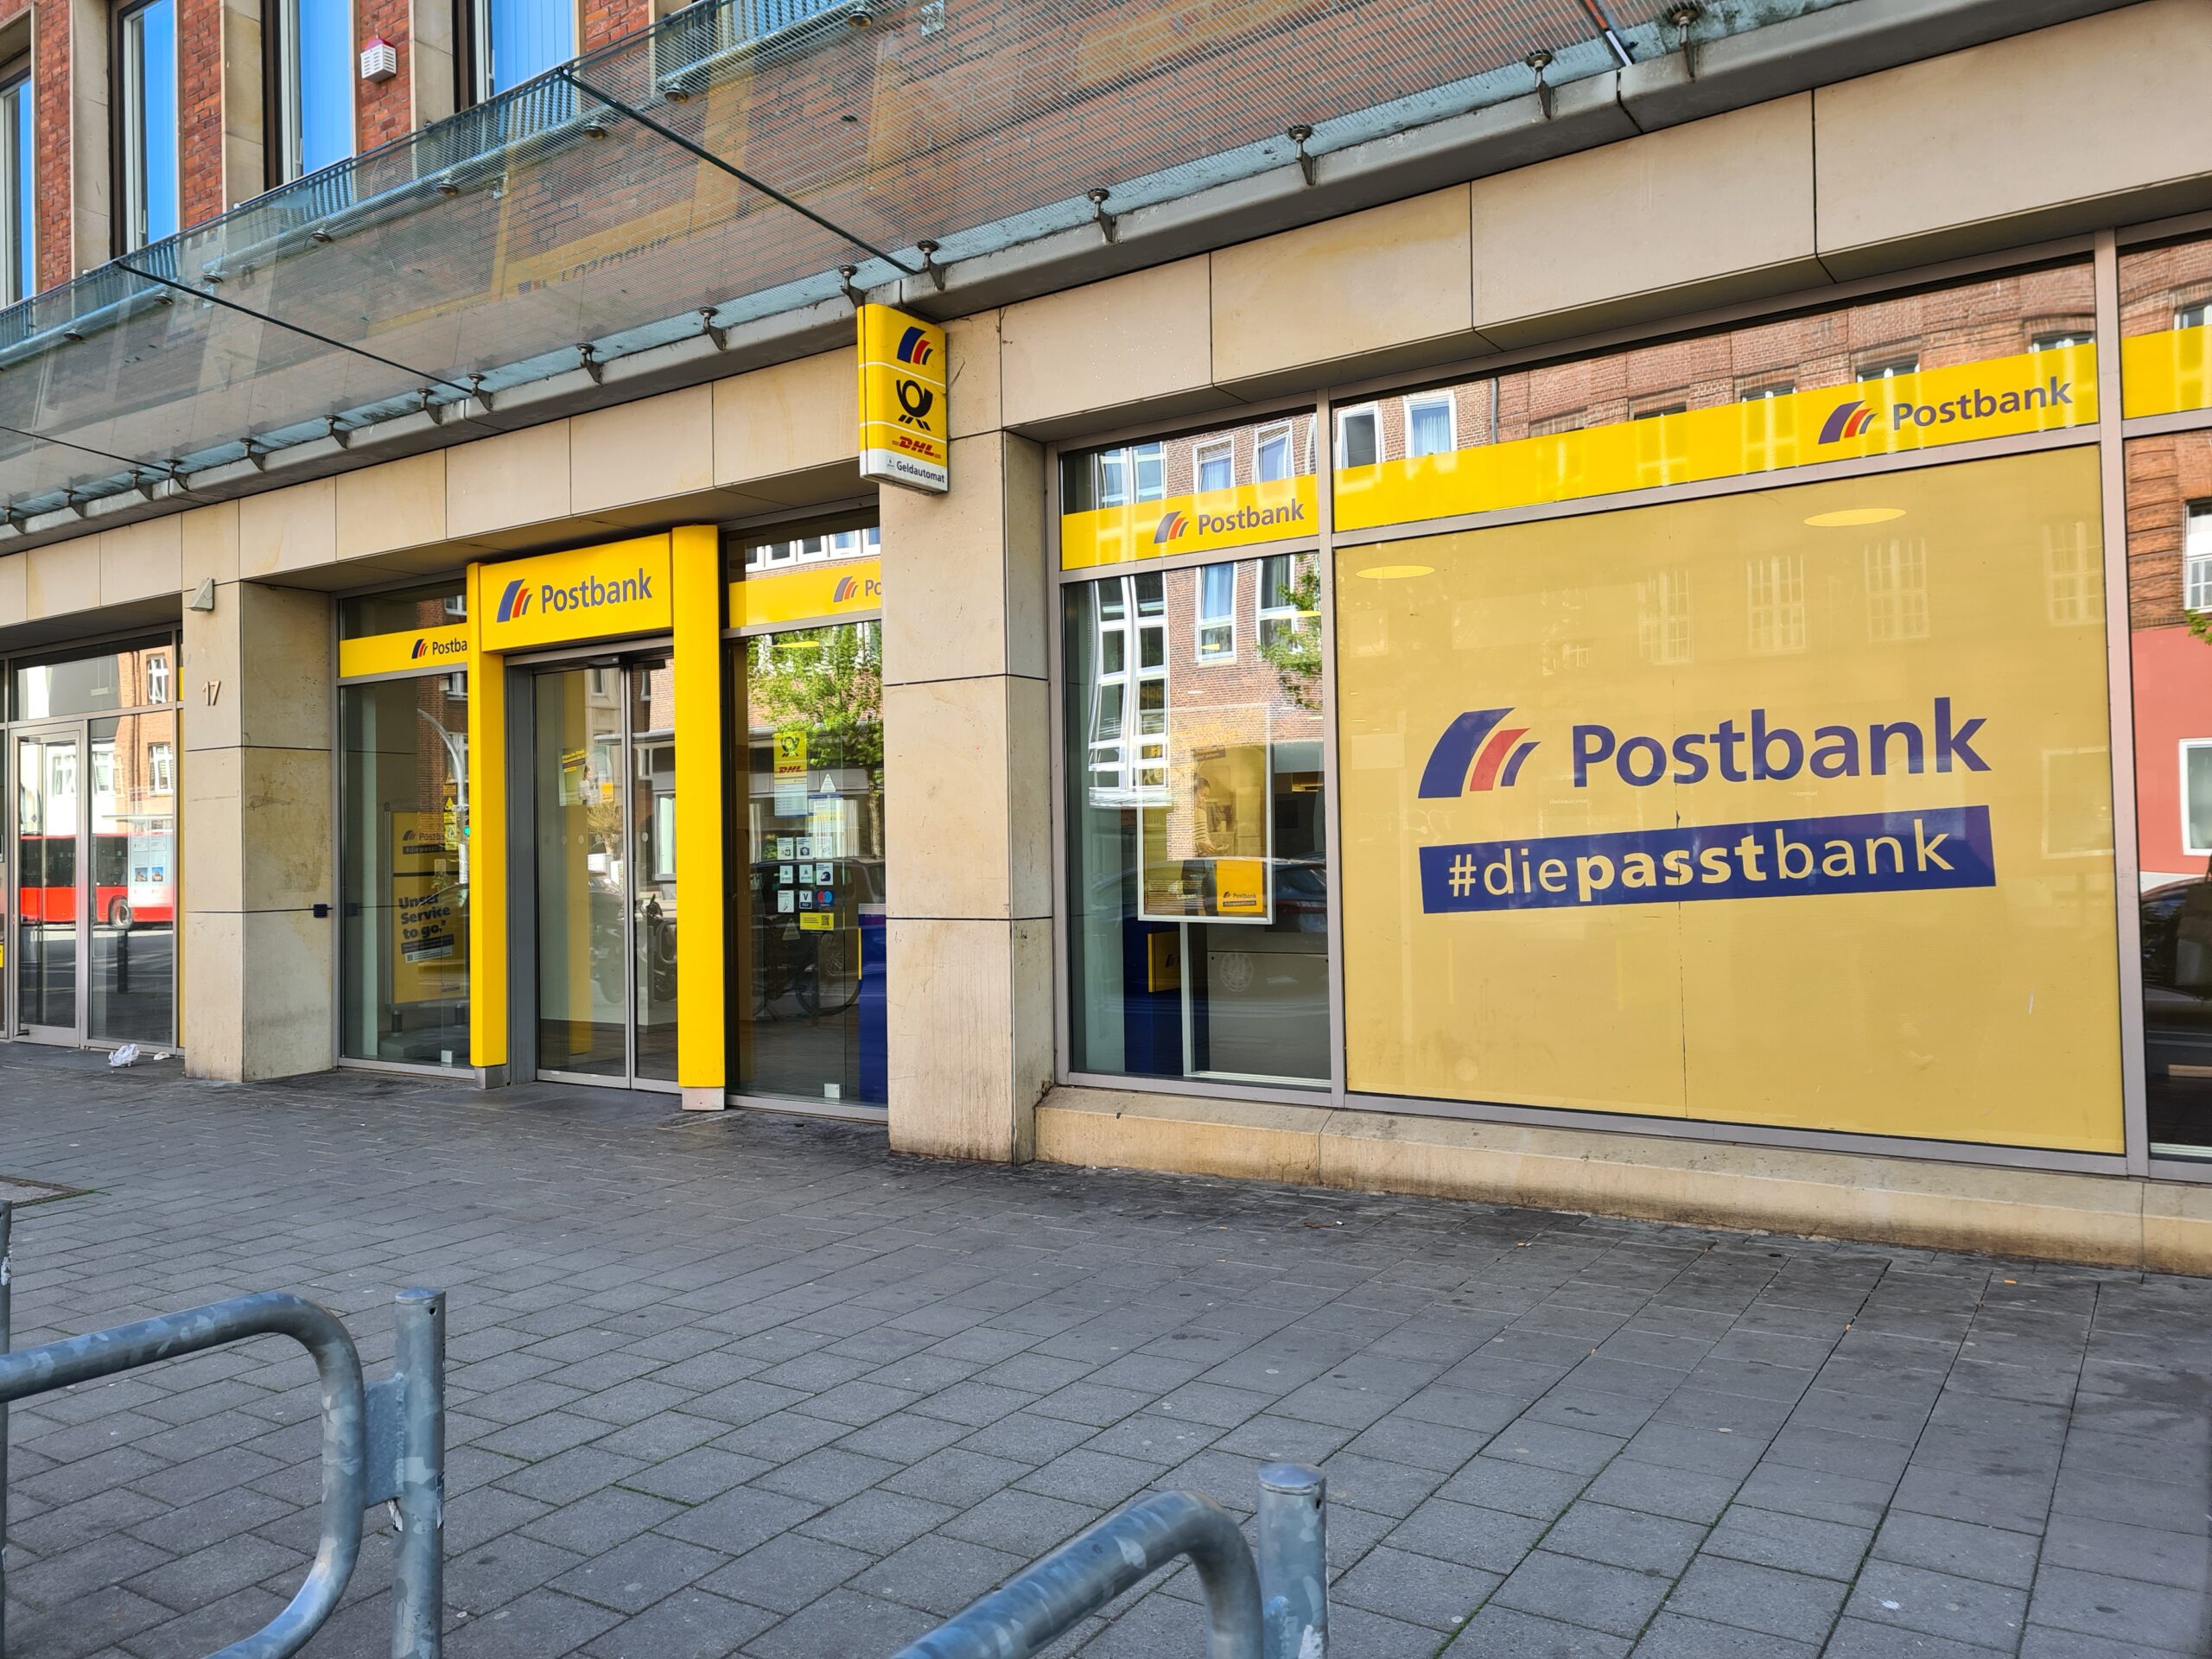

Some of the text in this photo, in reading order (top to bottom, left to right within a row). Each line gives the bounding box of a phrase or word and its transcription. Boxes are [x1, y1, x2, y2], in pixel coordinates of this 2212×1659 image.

[1893, 376, 2073, 431] Postbank
[899, 435, 935, 456] DHL
[896, 461, 945, 483] Geldautomat
[1198, 498, 1305, 536] Postbank
[541, 568, 652, 613] Postbank
[432, 638, 467, 655] Postba
[202, 679, 221, 706] 17
[1573, 696, 1993, 787] Postbank
[1448, 818, 1955, 901] #diepasstbank
[398, 893, 440, 909] Unser
[401, 906, 450, 925] Service
[403, 928, 418, 939] to
